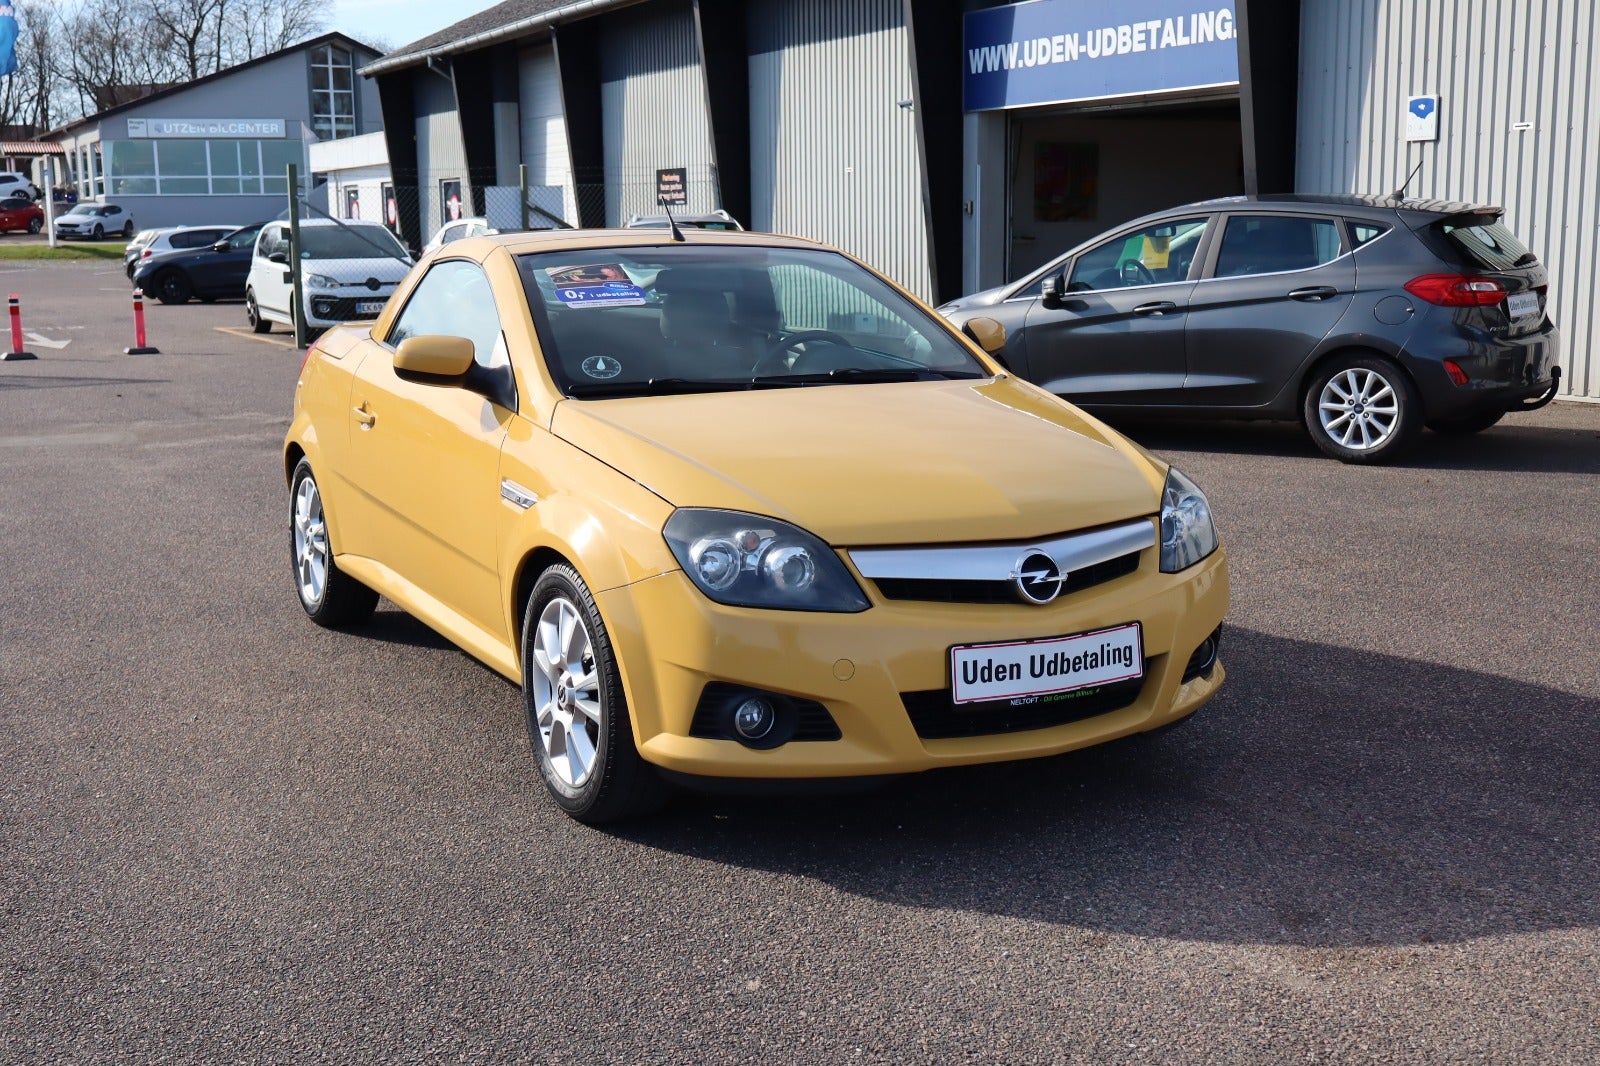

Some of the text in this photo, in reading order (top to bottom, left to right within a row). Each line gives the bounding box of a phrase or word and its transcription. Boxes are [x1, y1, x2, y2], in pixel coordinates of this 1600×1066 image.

[962, 643, 1133, 684] Uden Udbetaling
[1010, 696, 1039, 706] NELTOFT
